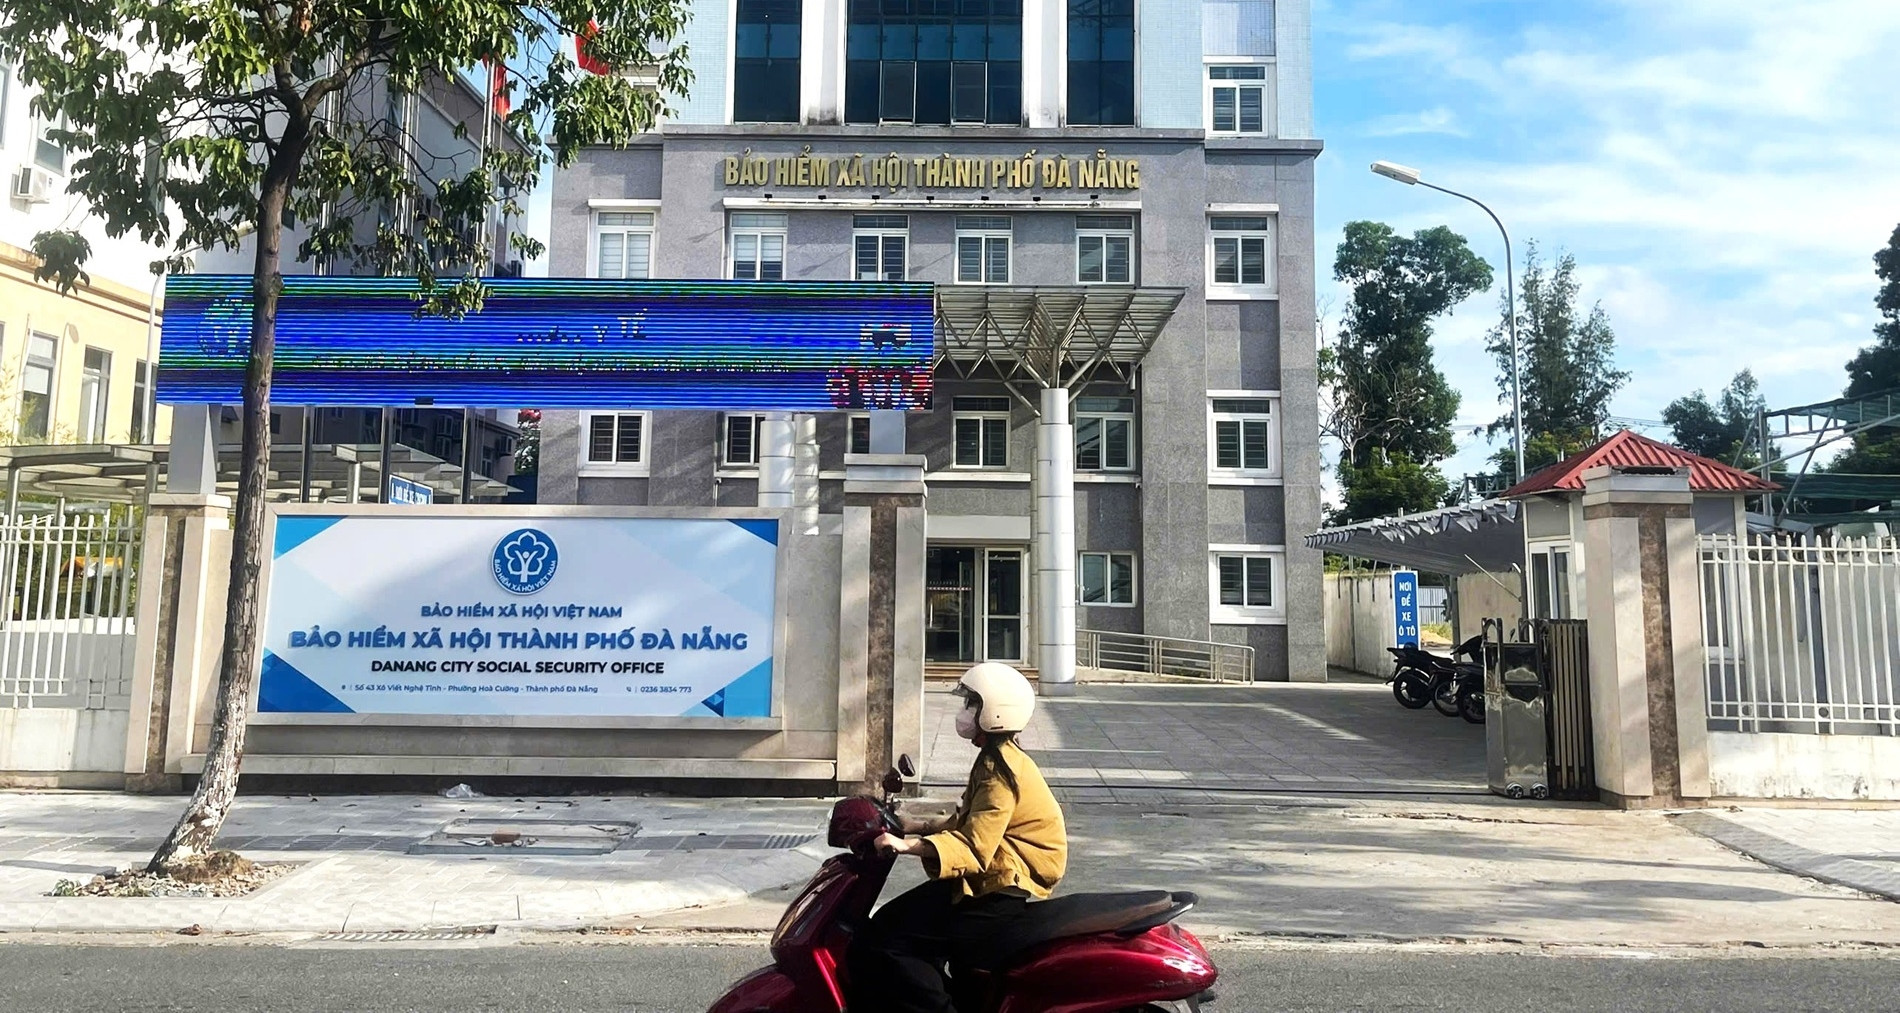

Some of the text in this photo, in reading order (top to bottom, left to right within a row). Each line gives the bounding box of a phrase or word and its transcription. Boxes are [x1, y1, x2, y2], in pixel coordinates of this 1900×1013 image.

[725, 145, 1140, 193] BẢO HIỂM XÃ HỘI THÀNH PHỐ ĐÀ NẴNG
[546, 560, 557, 577] NAM
[1398, 581, 1412, 592] NƠI
[420, 601, 623, 620] BẢO HIỂM XÃ HỘI VIỆT NAM
[1402, 611, 1412, 621] XE
[1398, 624, 1416, 636] Ô TÔ
[289, 625, 748, 652] BẢO HIỂM XÃ HỘI THÀNH PHỐ ĐÀ NẴNG
[371, 660, 665, 674] DANANG CITY SOCIAL SECURITY OFFICE
[403, 684, 424, 693] Nghệ
[526, 685, 549, 693] Thành
[550, 685, 565, 693] phố
[566, 685, 577, 693] Đà
